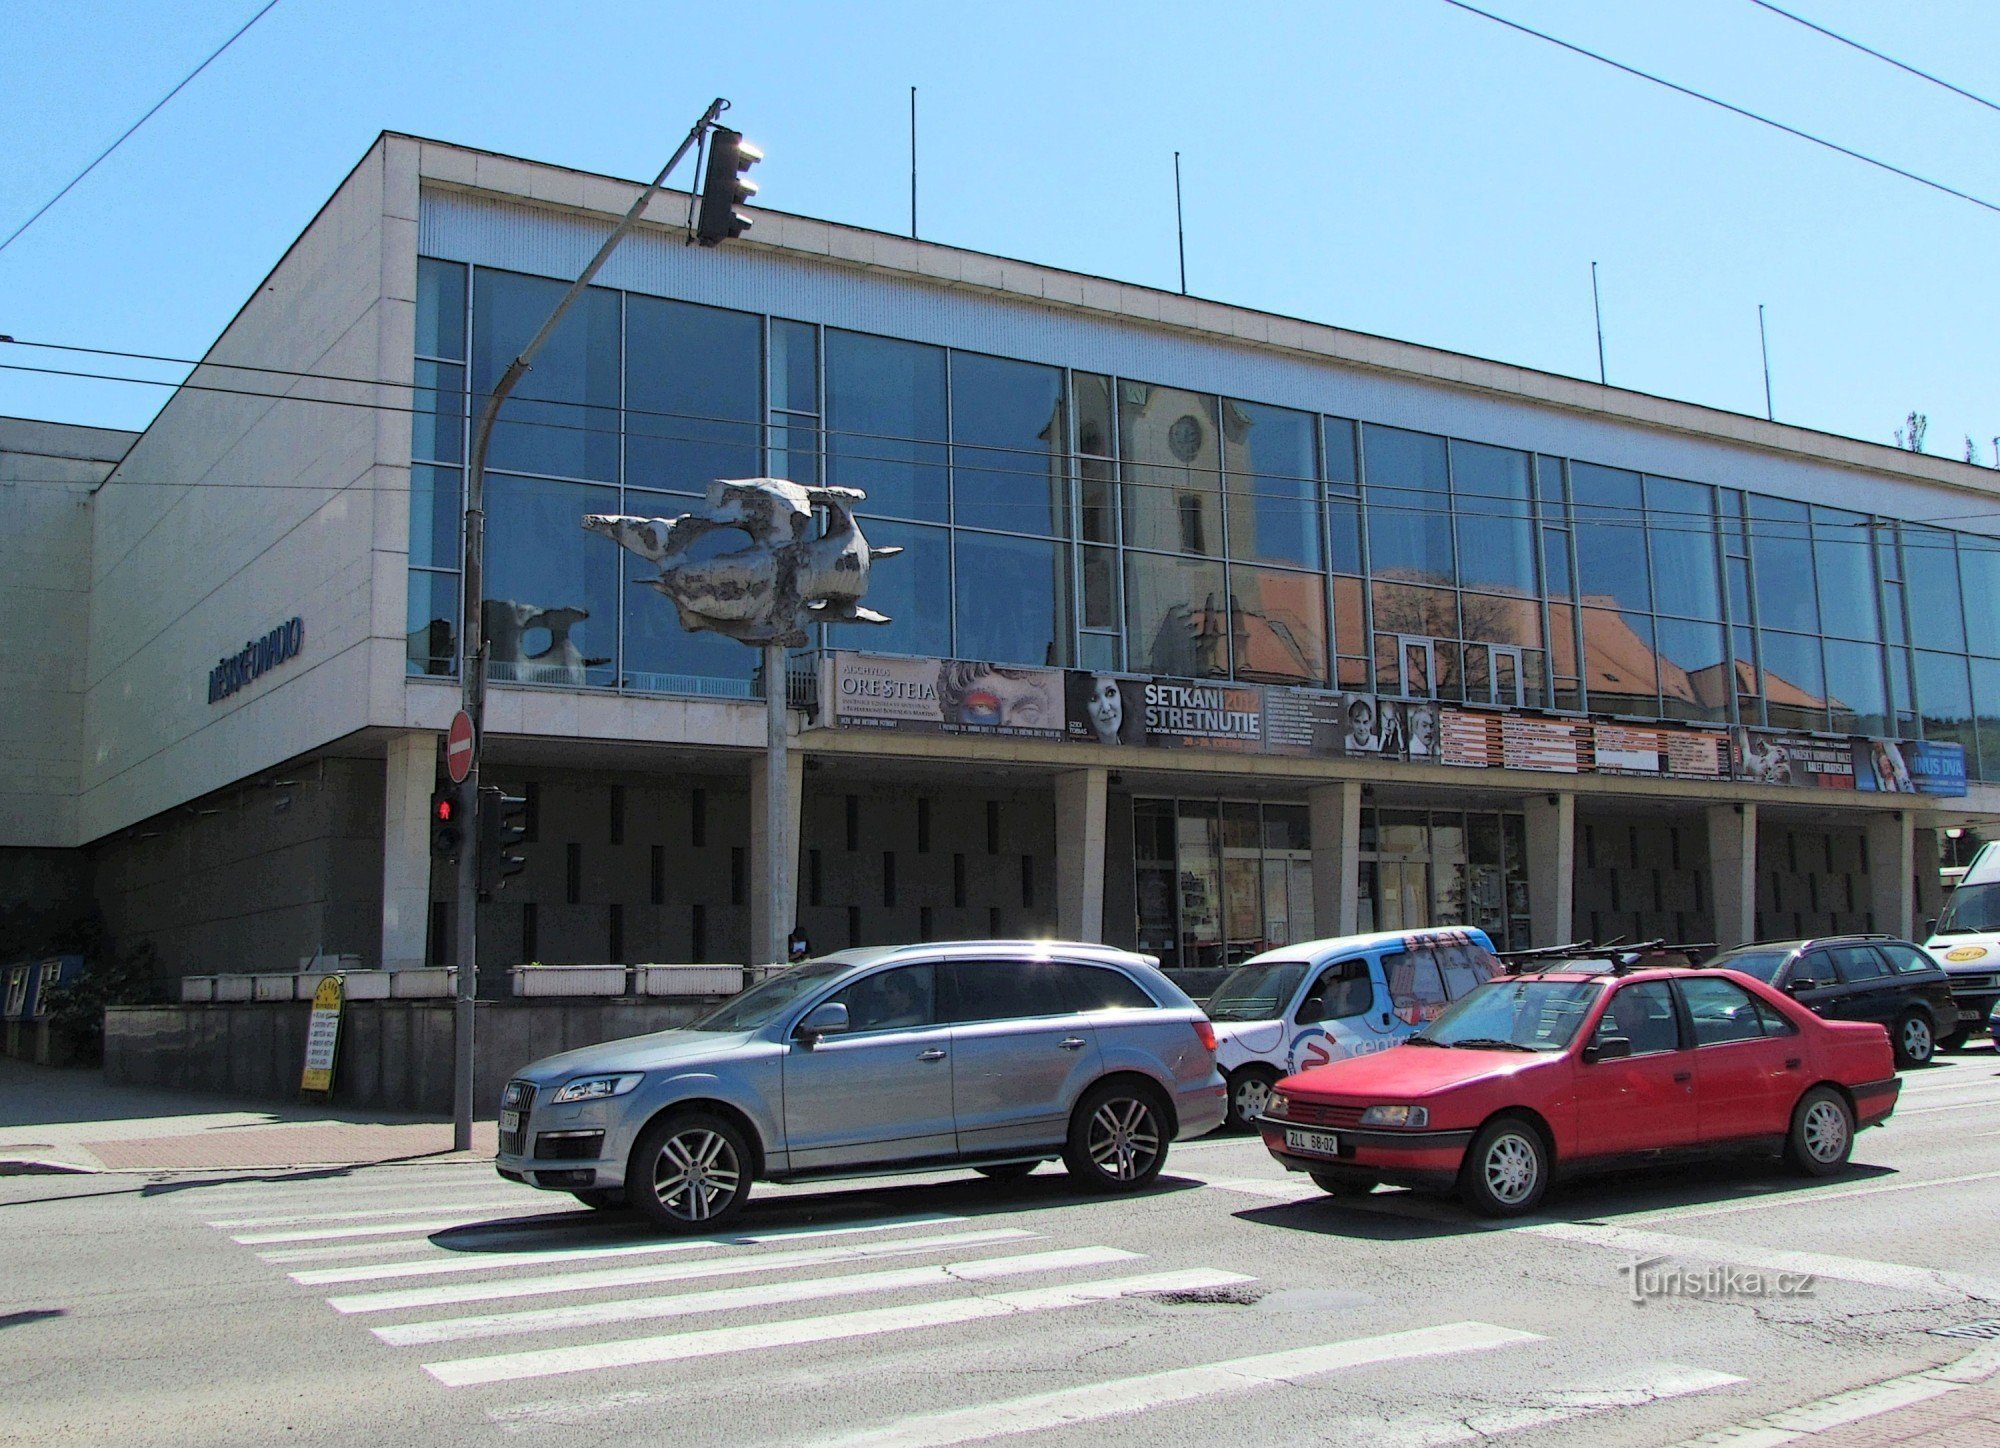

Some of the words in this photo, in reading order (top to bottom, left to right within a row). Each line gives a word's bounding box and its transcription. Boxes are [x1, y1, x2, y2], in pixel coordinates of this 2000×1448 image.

[841, 678, 936, 700] ORESTEIA
[1226, 692, 1259, 712] 2012
[1145, 705, 1260, 734] STRETNUTIE
